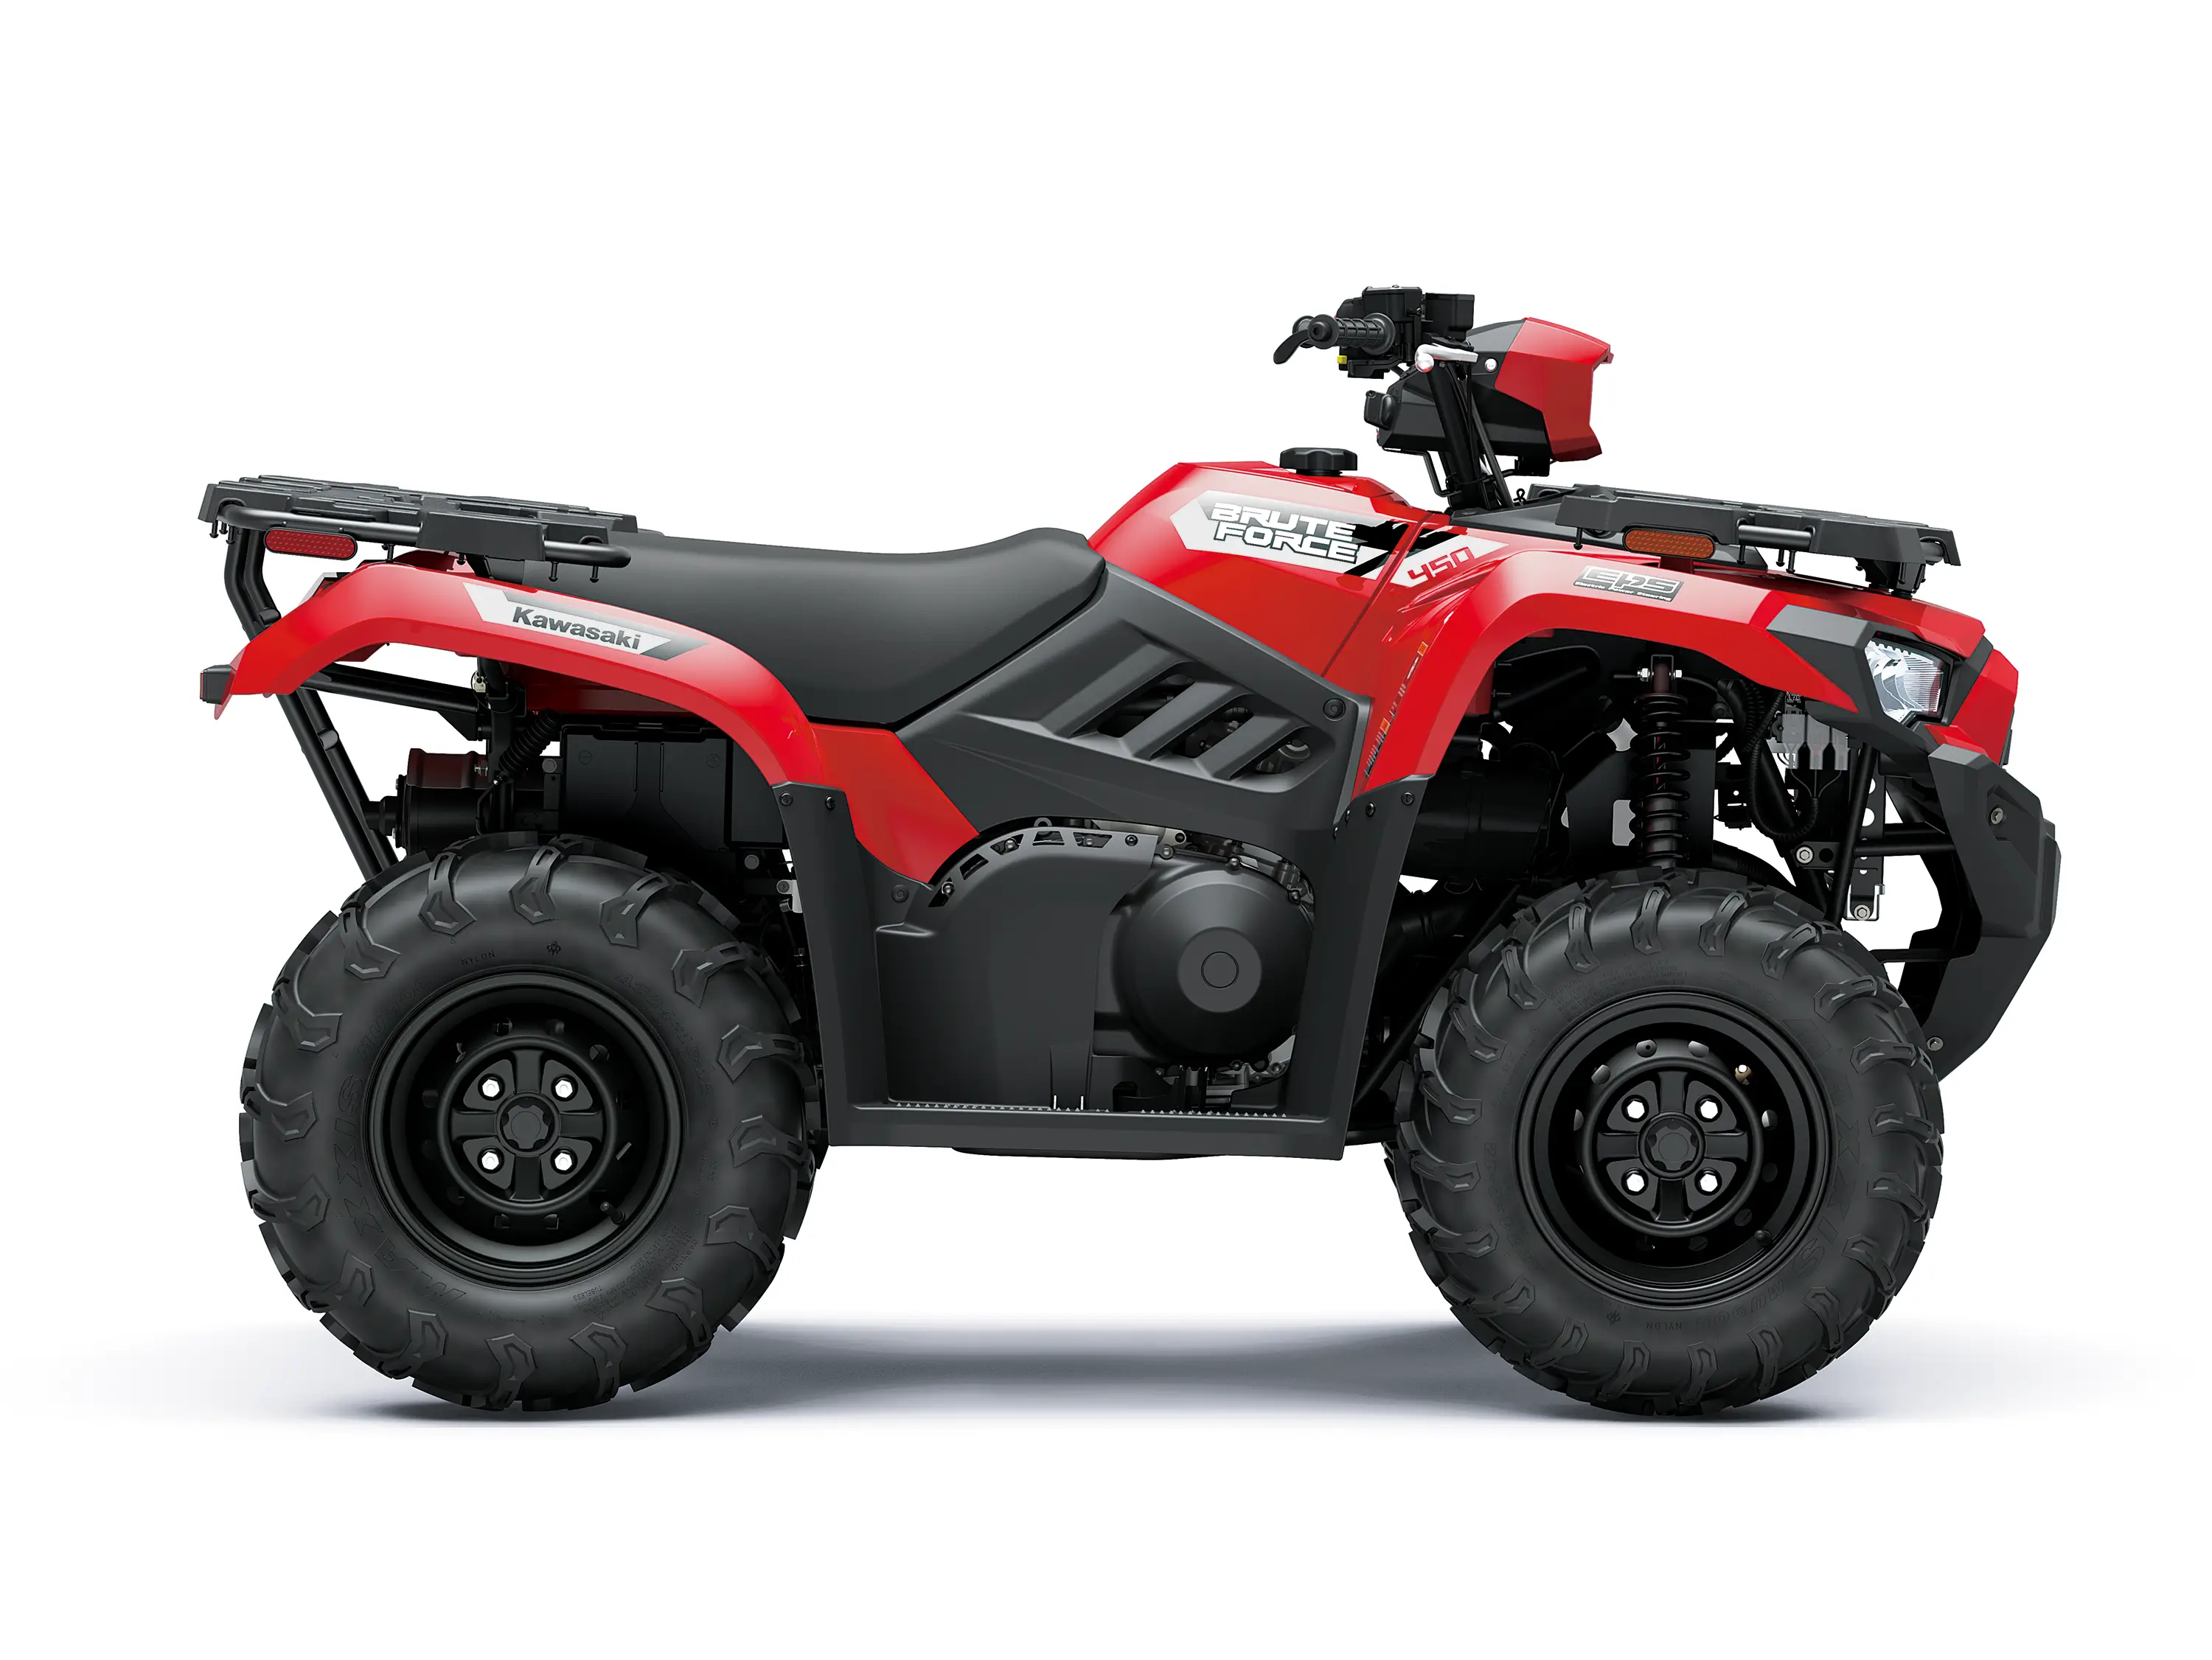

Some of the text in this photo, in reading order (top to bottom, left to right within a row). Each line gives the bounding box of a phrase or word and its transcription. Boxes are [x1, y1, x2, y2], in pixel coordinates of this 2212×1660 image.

[1210, 502, 1357, 542] BRUTE
[1214, 520, 1360, 565] FORCE
[1408, 546, 1475, 580] 450
[1582, 567, 1680, 594] EPS
[512, 607, 641, 649] Kawasaki
[460, 949, 496, 967] NYLON
[571, 1283, 603, 1302] TUBELESS
[1645, 1319, 1681, 1330] NYLON
